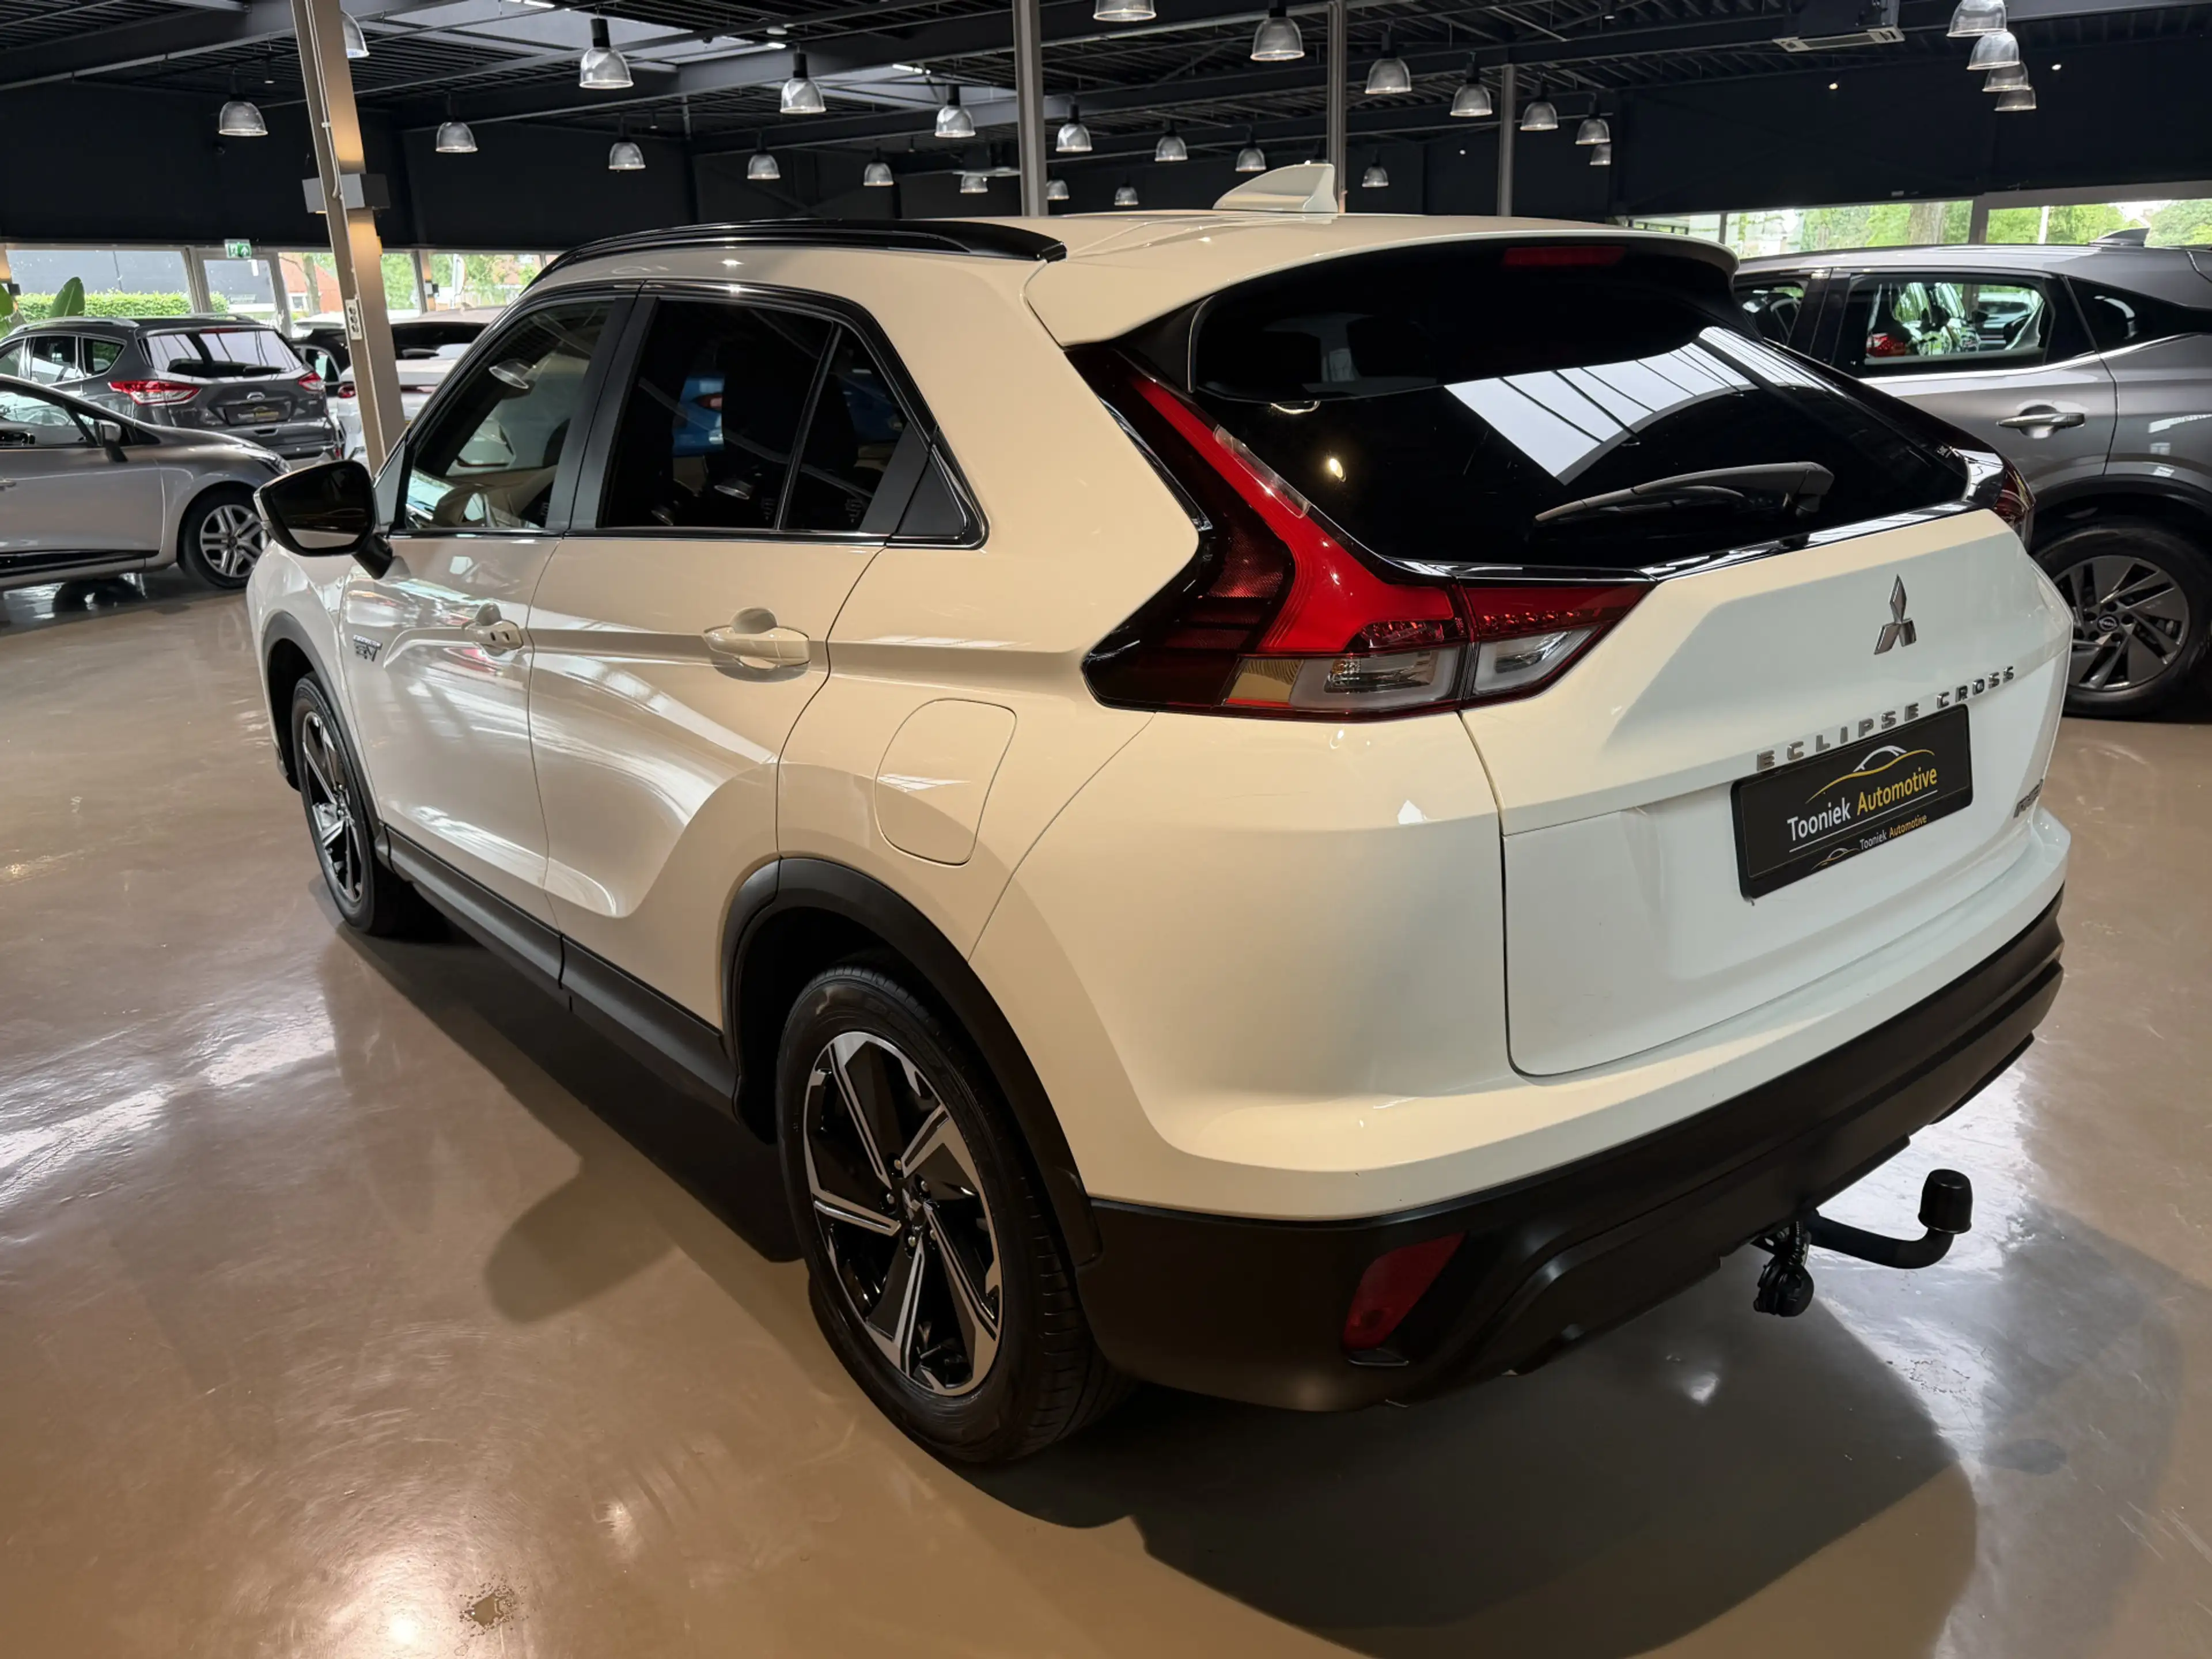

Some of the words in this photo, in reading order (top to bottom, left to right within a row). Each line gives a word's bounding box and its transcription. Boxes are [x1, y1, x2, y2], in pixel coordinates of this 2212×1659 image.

[1757, 703, 1919, 771] ECLIPSE
[1937, 665, 2014, 709] CROSS
[1787, 791, 1851, 841] Tooniek
[1857, 767, 1938, 816] Automotive
[1859, 830, 1887, 851] Tooniek
[1889, 814, 1927, 838] Automotive
